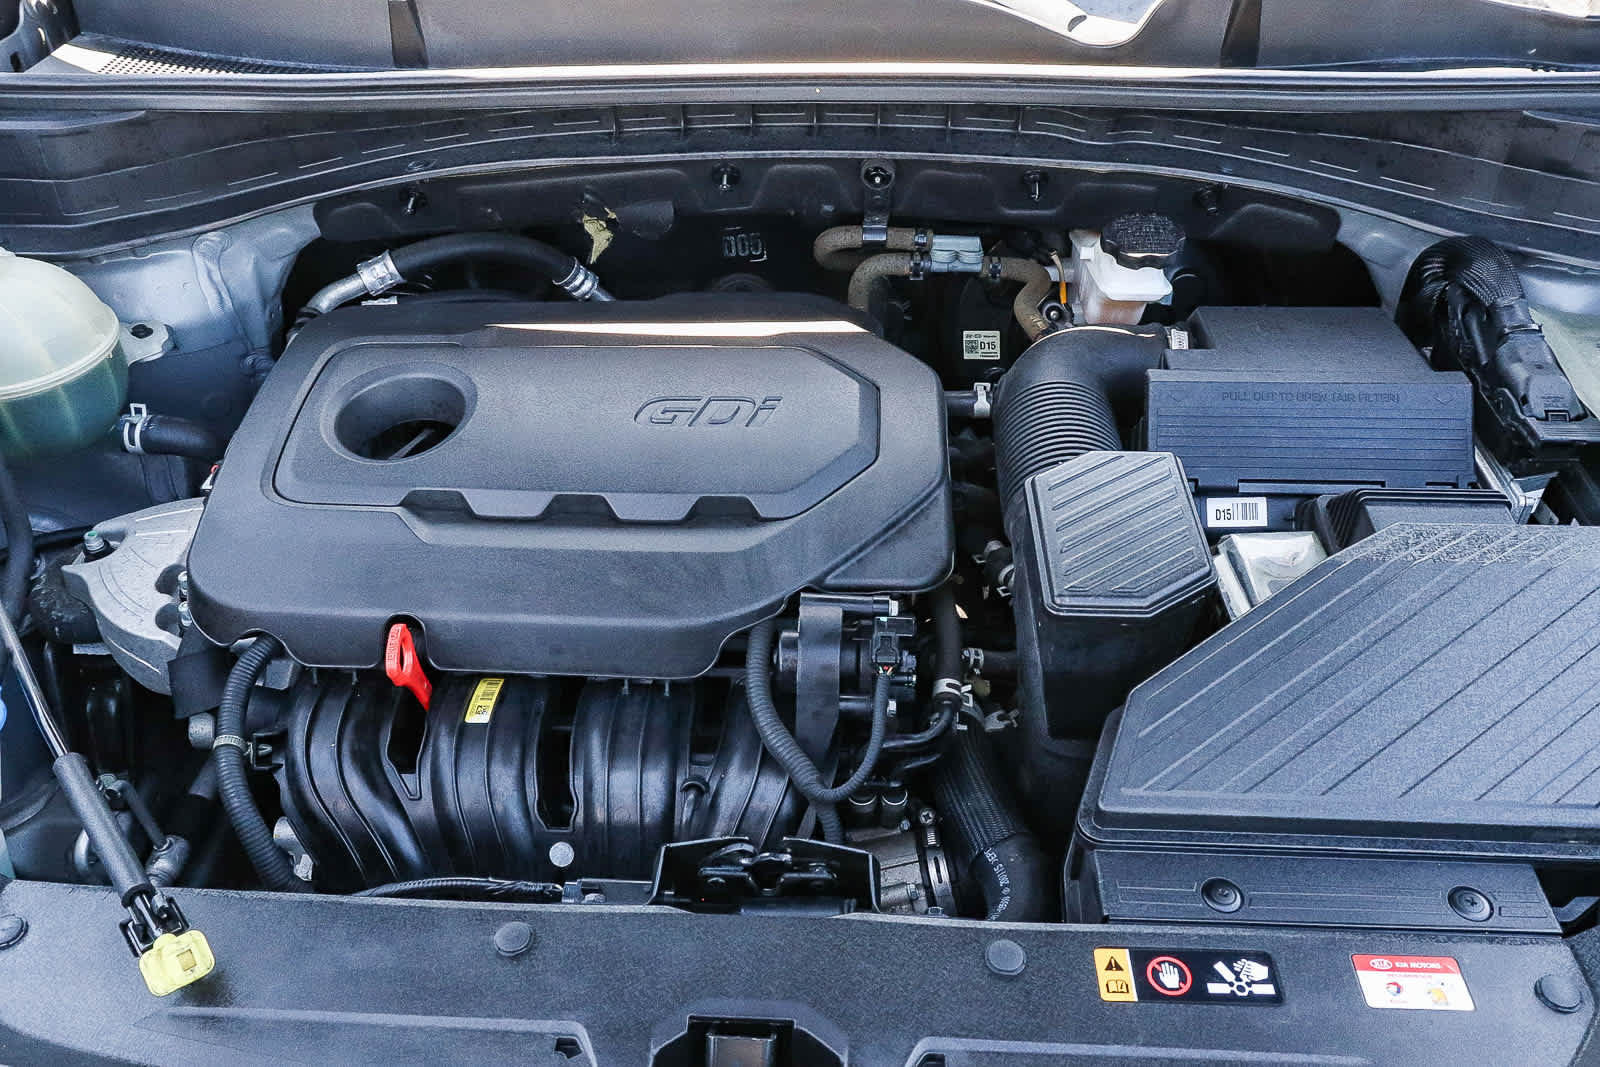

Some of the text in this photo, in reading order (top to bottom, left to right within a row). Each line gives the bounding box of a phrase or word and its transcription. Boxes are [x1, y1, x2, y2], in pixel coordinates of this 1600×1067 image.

[980, 341, 996, 350] D15
[1222, 391, 1251, 401] PULL
[1253, 391, 1278, 401] OUT
[1279, 392, 1294, 401] TO
[1296, 392, 1328, 402] OPEN
[1215, 508, 1232, 521] D15
[1370, 959, 1393, 970] KIA
